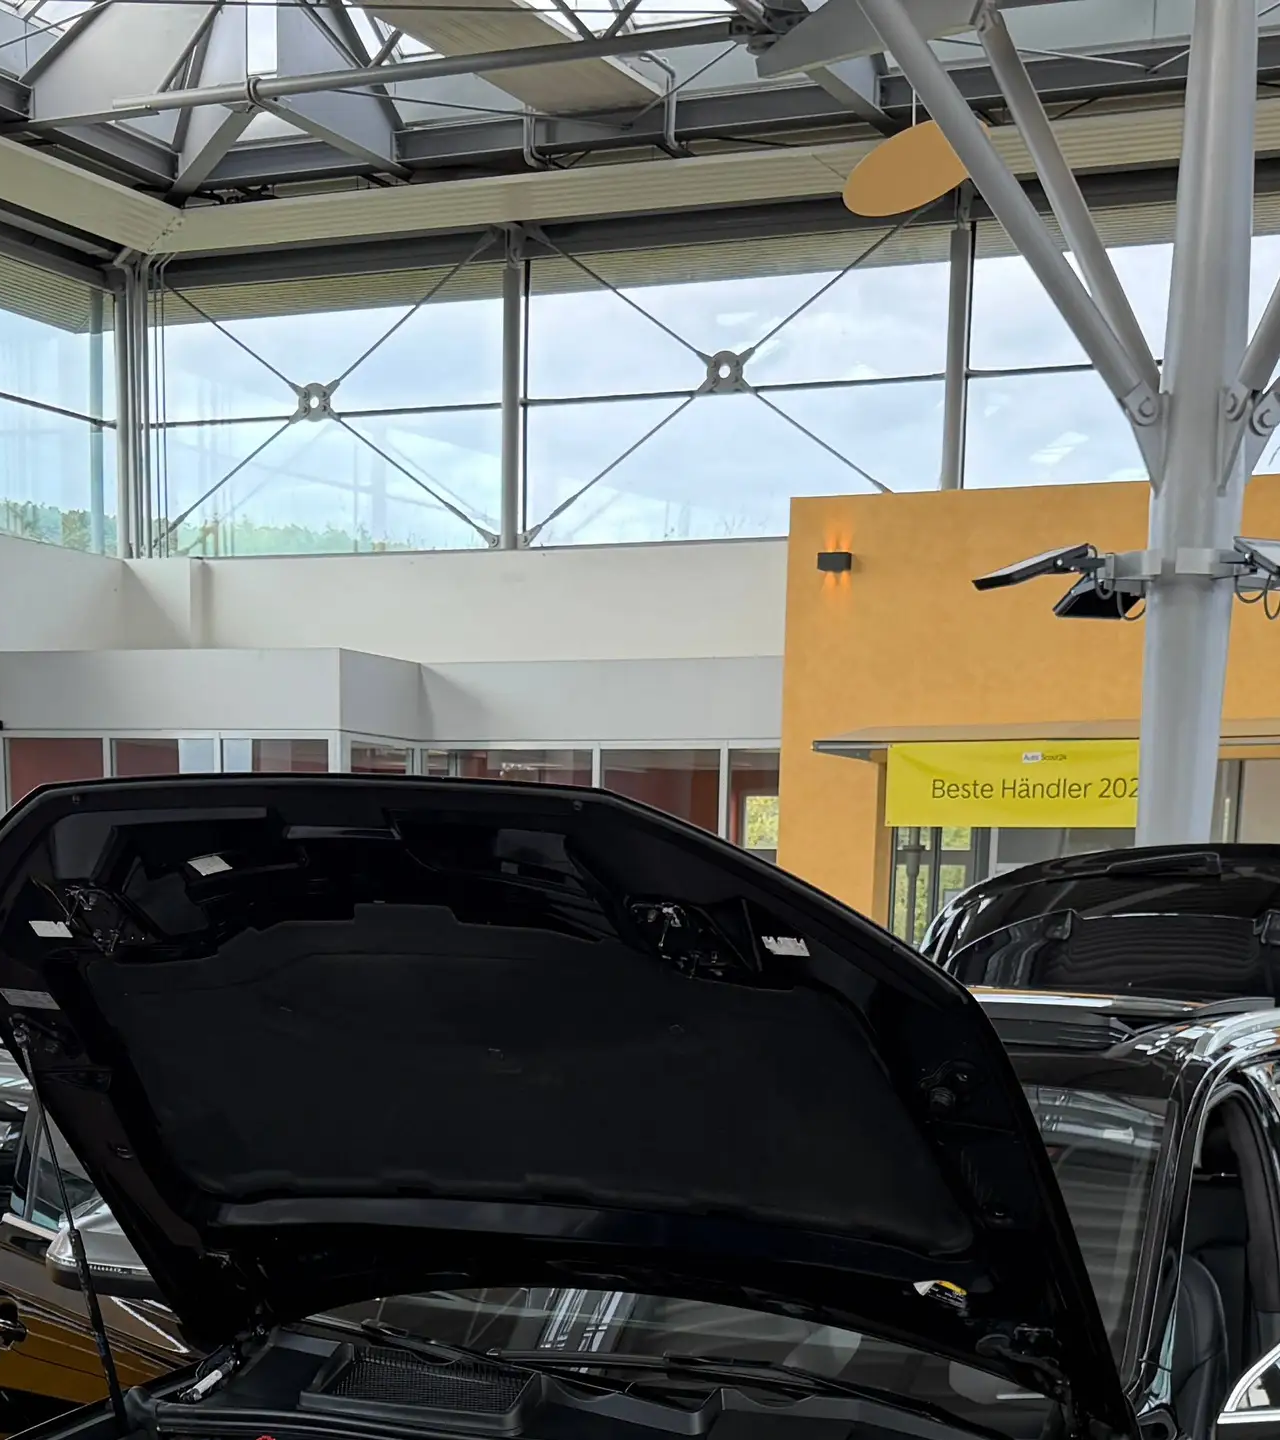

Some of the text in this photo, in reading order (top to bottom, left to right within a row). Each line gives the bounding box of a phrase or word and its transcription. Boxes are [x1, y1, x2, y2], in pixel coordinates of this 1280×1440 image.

[931, 777, 1139, 800] Beste Händler 202
